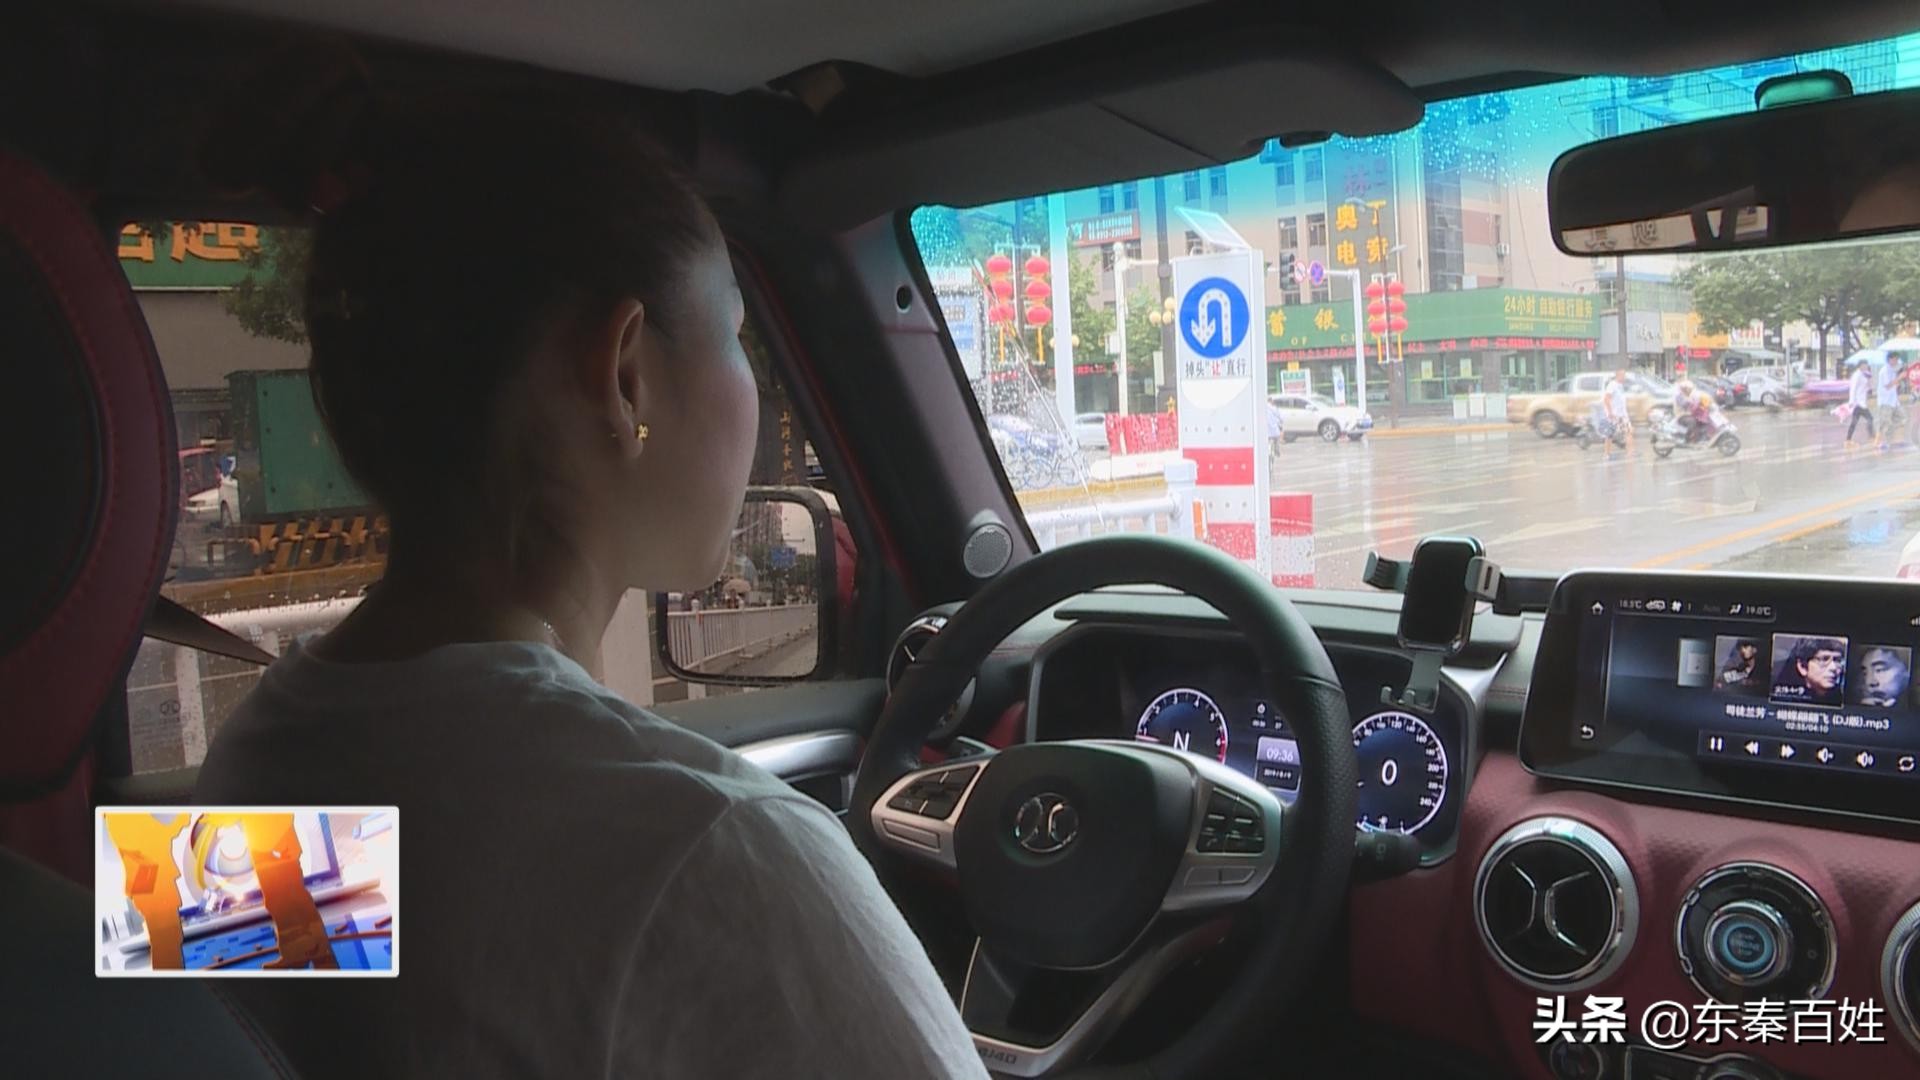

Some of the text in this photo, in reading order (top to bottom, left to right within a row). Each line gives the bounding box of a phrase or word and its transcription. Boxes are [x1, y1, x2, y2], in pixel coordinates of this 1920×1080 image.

[1173, 730, 1191, 752] N
[1266, 747, 1294, 763] 09:36
[1381, 759, 1398, 786] 0
